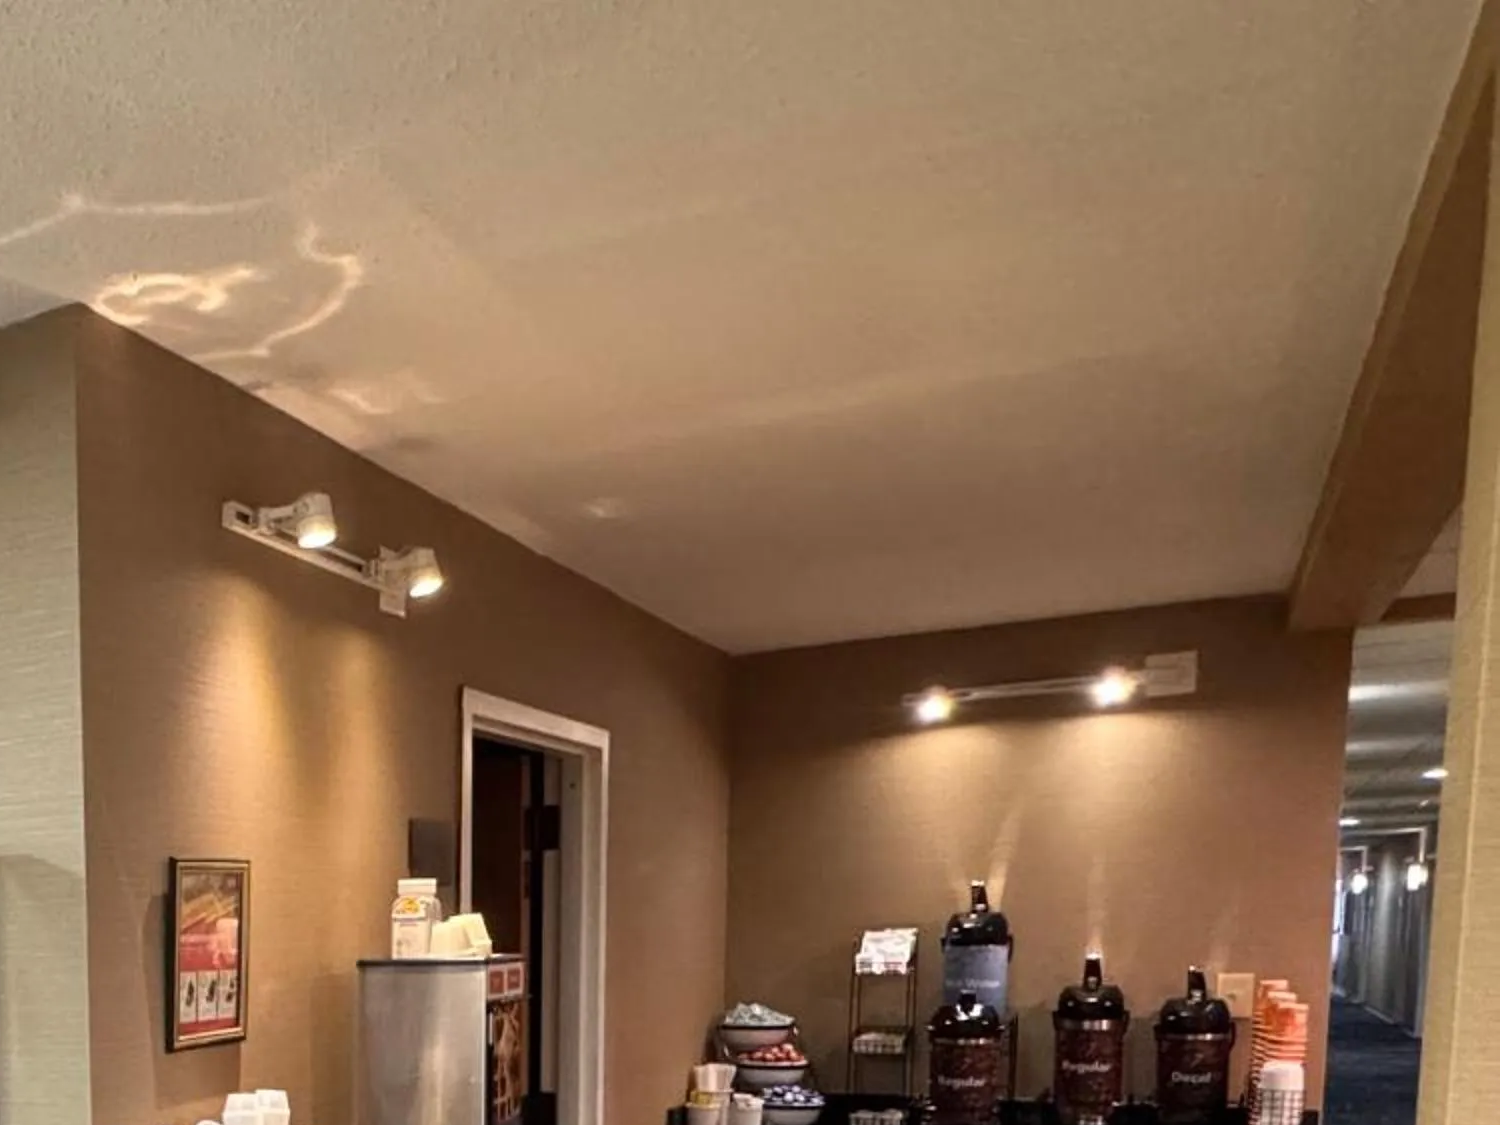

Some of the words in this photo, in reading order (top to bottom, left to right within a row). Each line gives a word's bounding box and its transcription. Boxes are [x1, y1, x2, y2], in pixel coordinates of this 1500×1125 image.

[1062, 1060, 1111, 1073] Regular
[938, 1075, 986, 1090] Regular
[1171, 1071, 1212, 1084] Decaf
